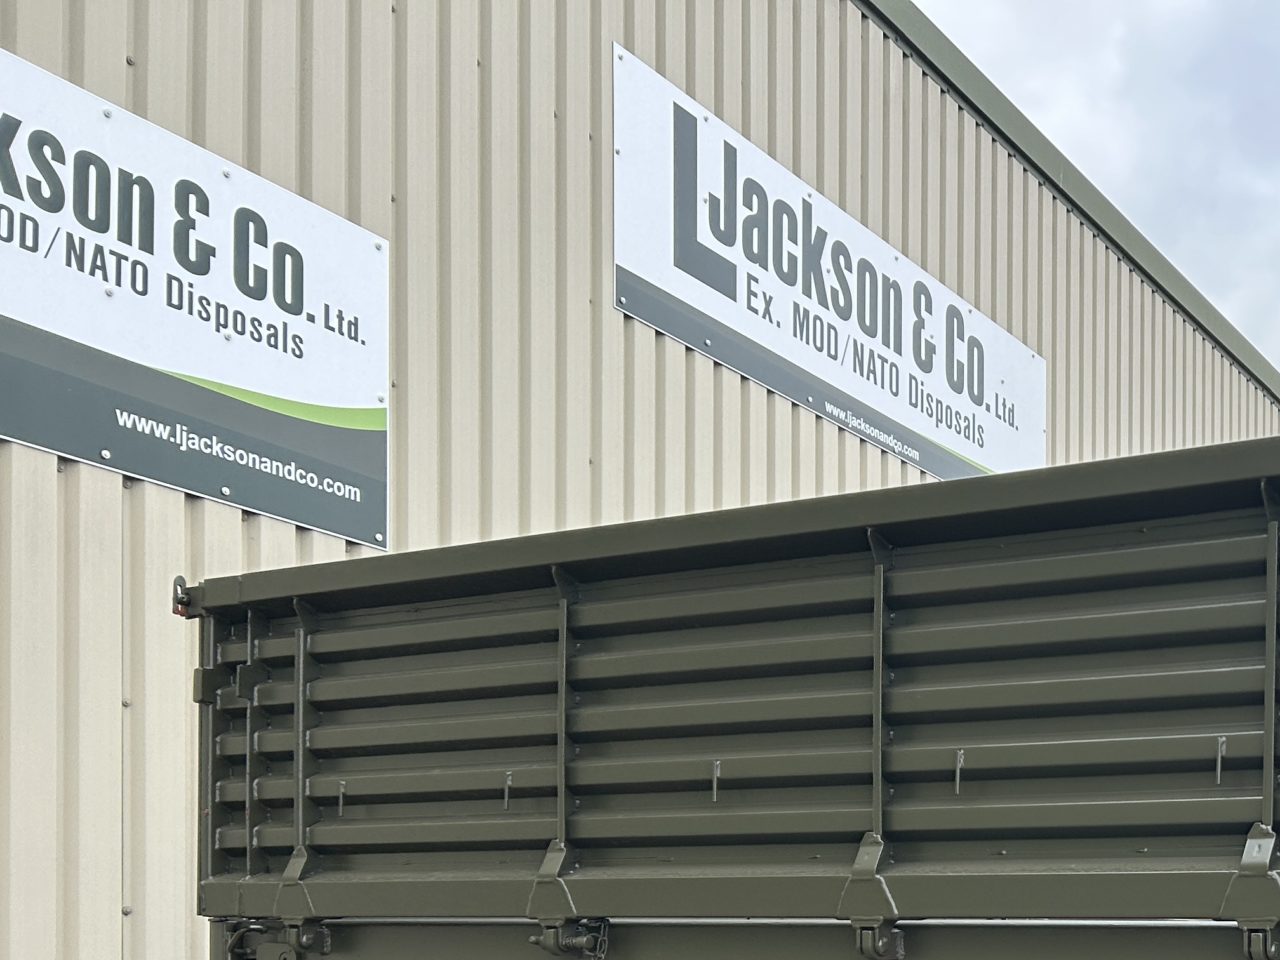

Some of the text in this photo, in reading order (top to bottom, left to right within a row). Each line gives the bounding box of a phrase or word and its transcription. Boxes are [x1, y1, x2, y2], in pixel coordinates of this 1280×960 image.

[166, 272, 305, 360] Disposals
[173, 179, 216, 275] &
[233, 206, 316, 324] Co.
[323, 303, 367, 346] Ltd.
[746, 272, 985, 449] Ex. MOD/NATO Disposals
[912, 280, 937, 374] &
[945, 303, 991, 412] Co.
[994, 392, 1020, 432] Ltd.
[115, 408, 362, 503] www.ljacksonandco.com
